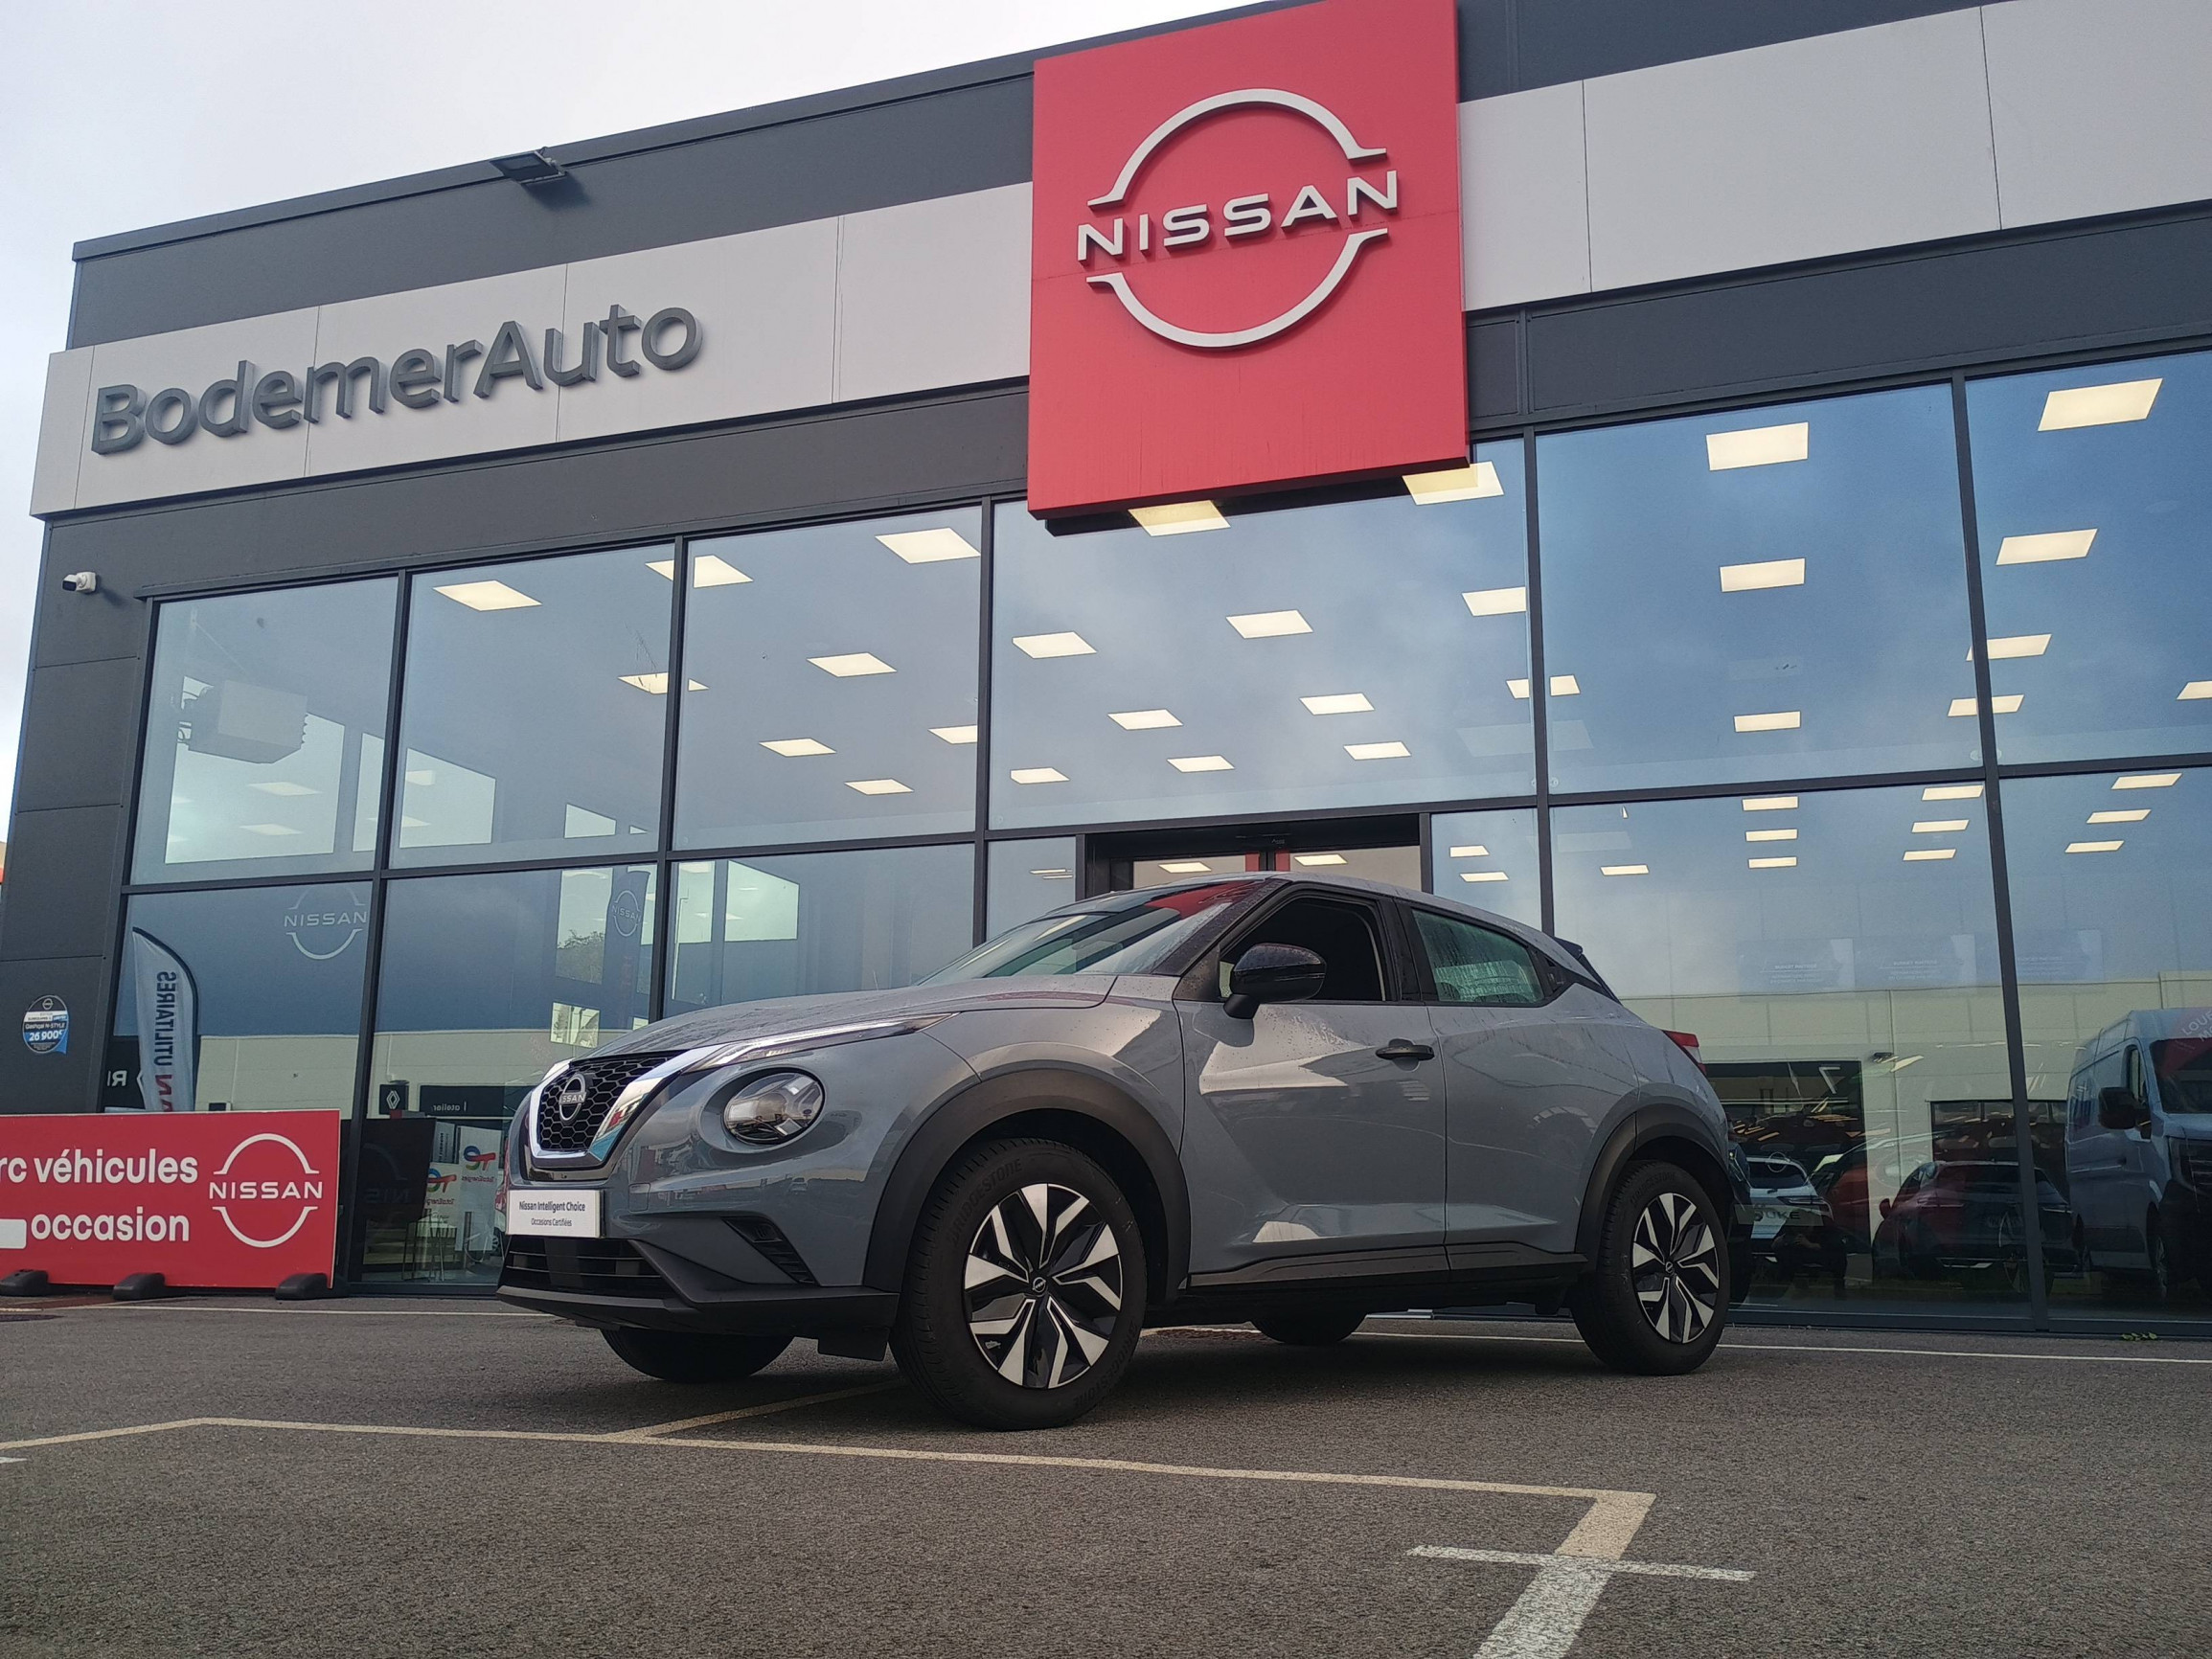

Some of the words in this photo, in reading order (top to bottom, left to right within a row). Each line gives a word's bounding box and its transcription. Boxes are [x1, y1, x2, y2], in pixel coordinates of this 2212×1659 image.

[1077, 170, 1398, 265] NISSAN
[91, 304, 703, 454] BodemerAuto
[284, 911, 368, 927] NISSAN
[611, 905, 641, 922] NISSAN
[29, 1032, 40, 1041] 26
[34, 1148, 198, 1184] véhicules
[209, 1181, 323, 1199] NISSAN
[518, 1200, 536, 1211] Nissan
[537, 1200, 565, 1214] Intelligent
[566, 1201, 585, 1212] Choice
[31, 1206, 190, 1241] occasion
[531, 1217, 552, 1226] Occasions
